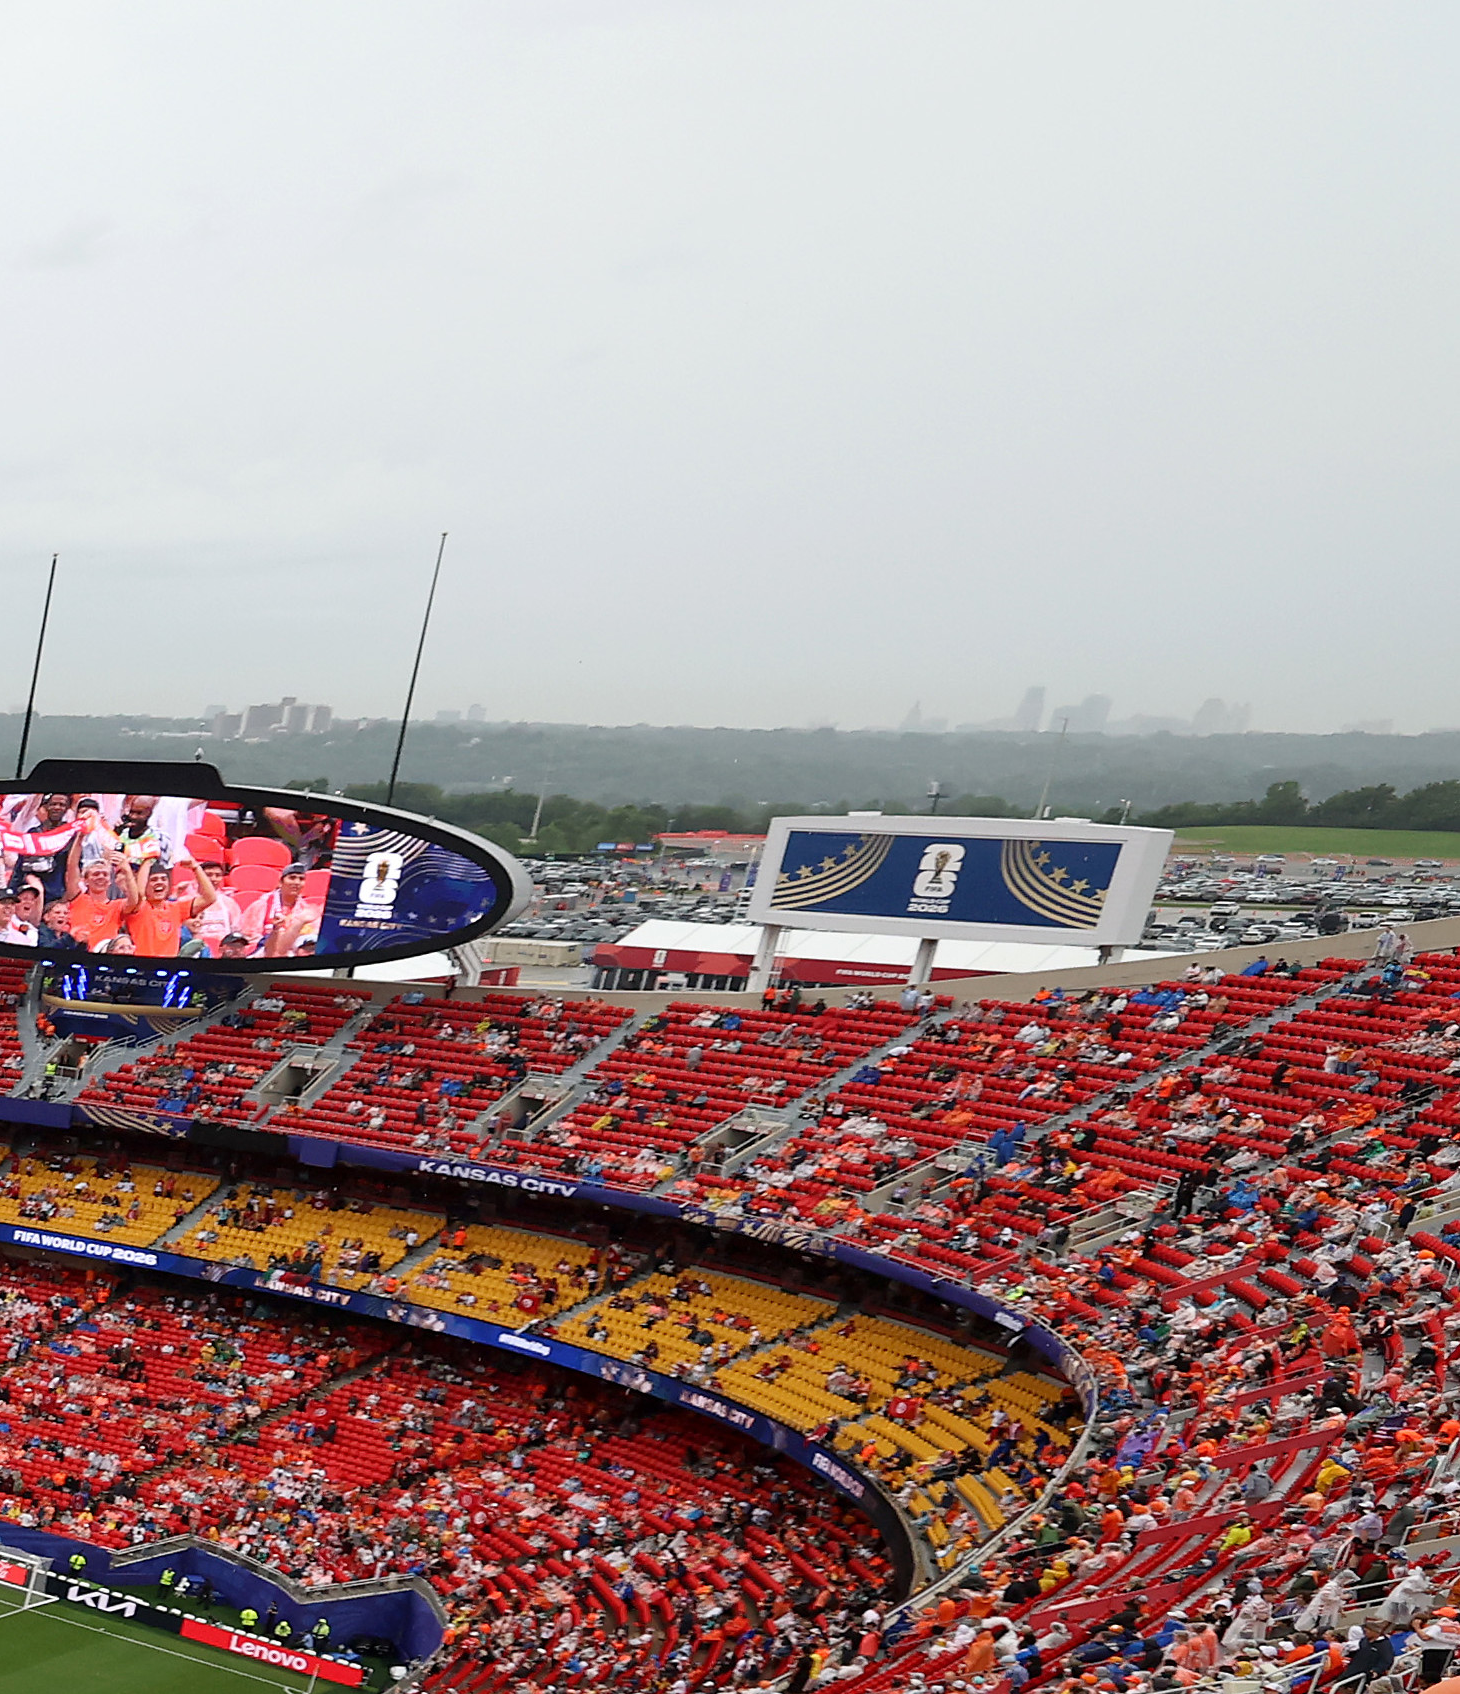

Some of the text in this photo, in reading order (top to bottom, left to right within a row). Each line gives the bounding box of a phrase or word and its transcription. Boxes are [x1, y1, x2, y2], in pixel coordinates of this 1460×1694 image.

[906, 903, 949, 914] 2026
[94, 975, 147, 987] KANSAS
[419, 1160, 577, 1197] KANSAS CITY
[13, 1229, 157, 1265] FIFA WORLD CUP 2026
[315, 1287, 351, 1306] CITY
[229, 1635, 308, 1670] Lenovo
